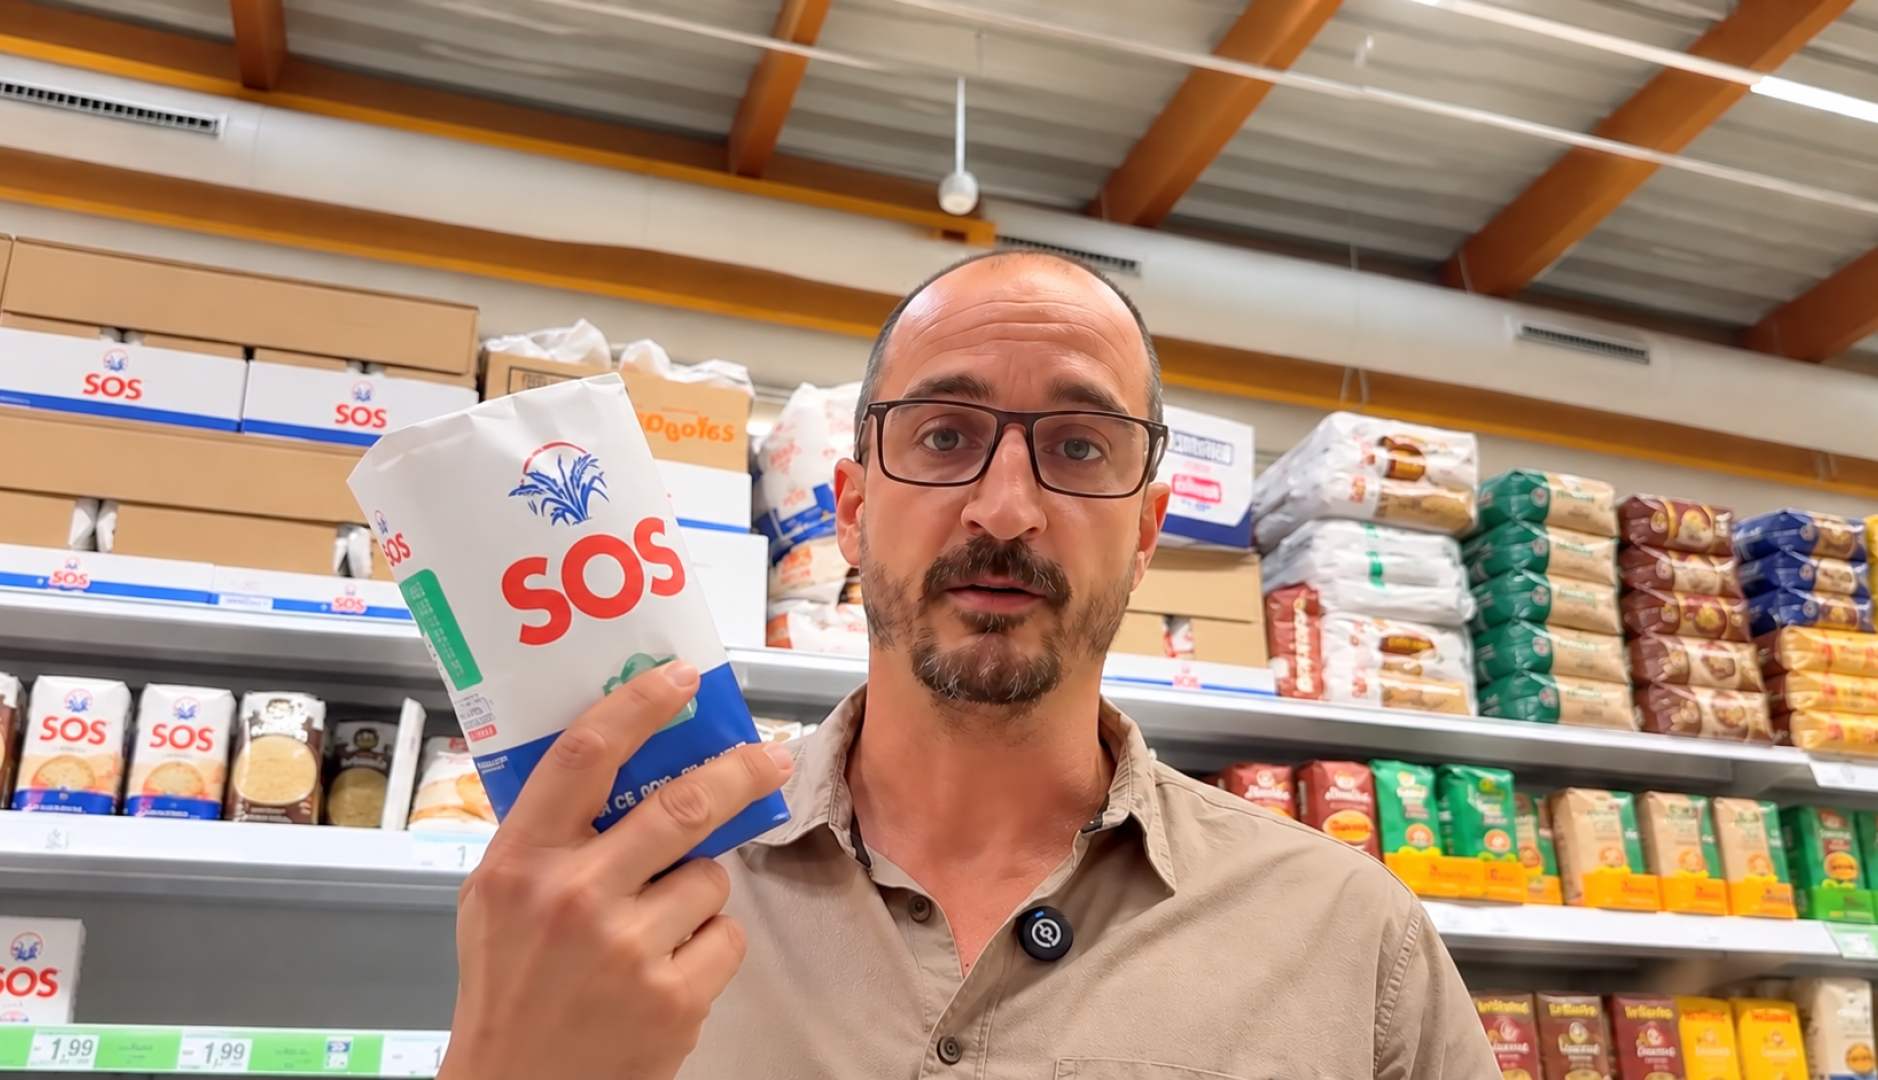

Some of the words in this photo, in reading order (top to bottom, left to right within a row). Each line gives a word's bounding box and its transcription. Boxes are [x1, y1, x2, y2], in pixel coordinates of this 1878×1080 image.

[82, 372, 143, 401] SOS
[335, 403, 388, 429] SOS
[51, 570, 88, 586] SOS
[502, 517, 686, 646] SOS
[334, 597, 365, 612] SOS
[1174, 676, 1199, 689] SOS
[39, 715, 107, 746] SOS
[149, 722, 215, 753] SOS
[0, 966, 59, 999] OS
[51, 1037, 94, 1063] 1,99
[204, 1041, 245, 1067] 1,99
